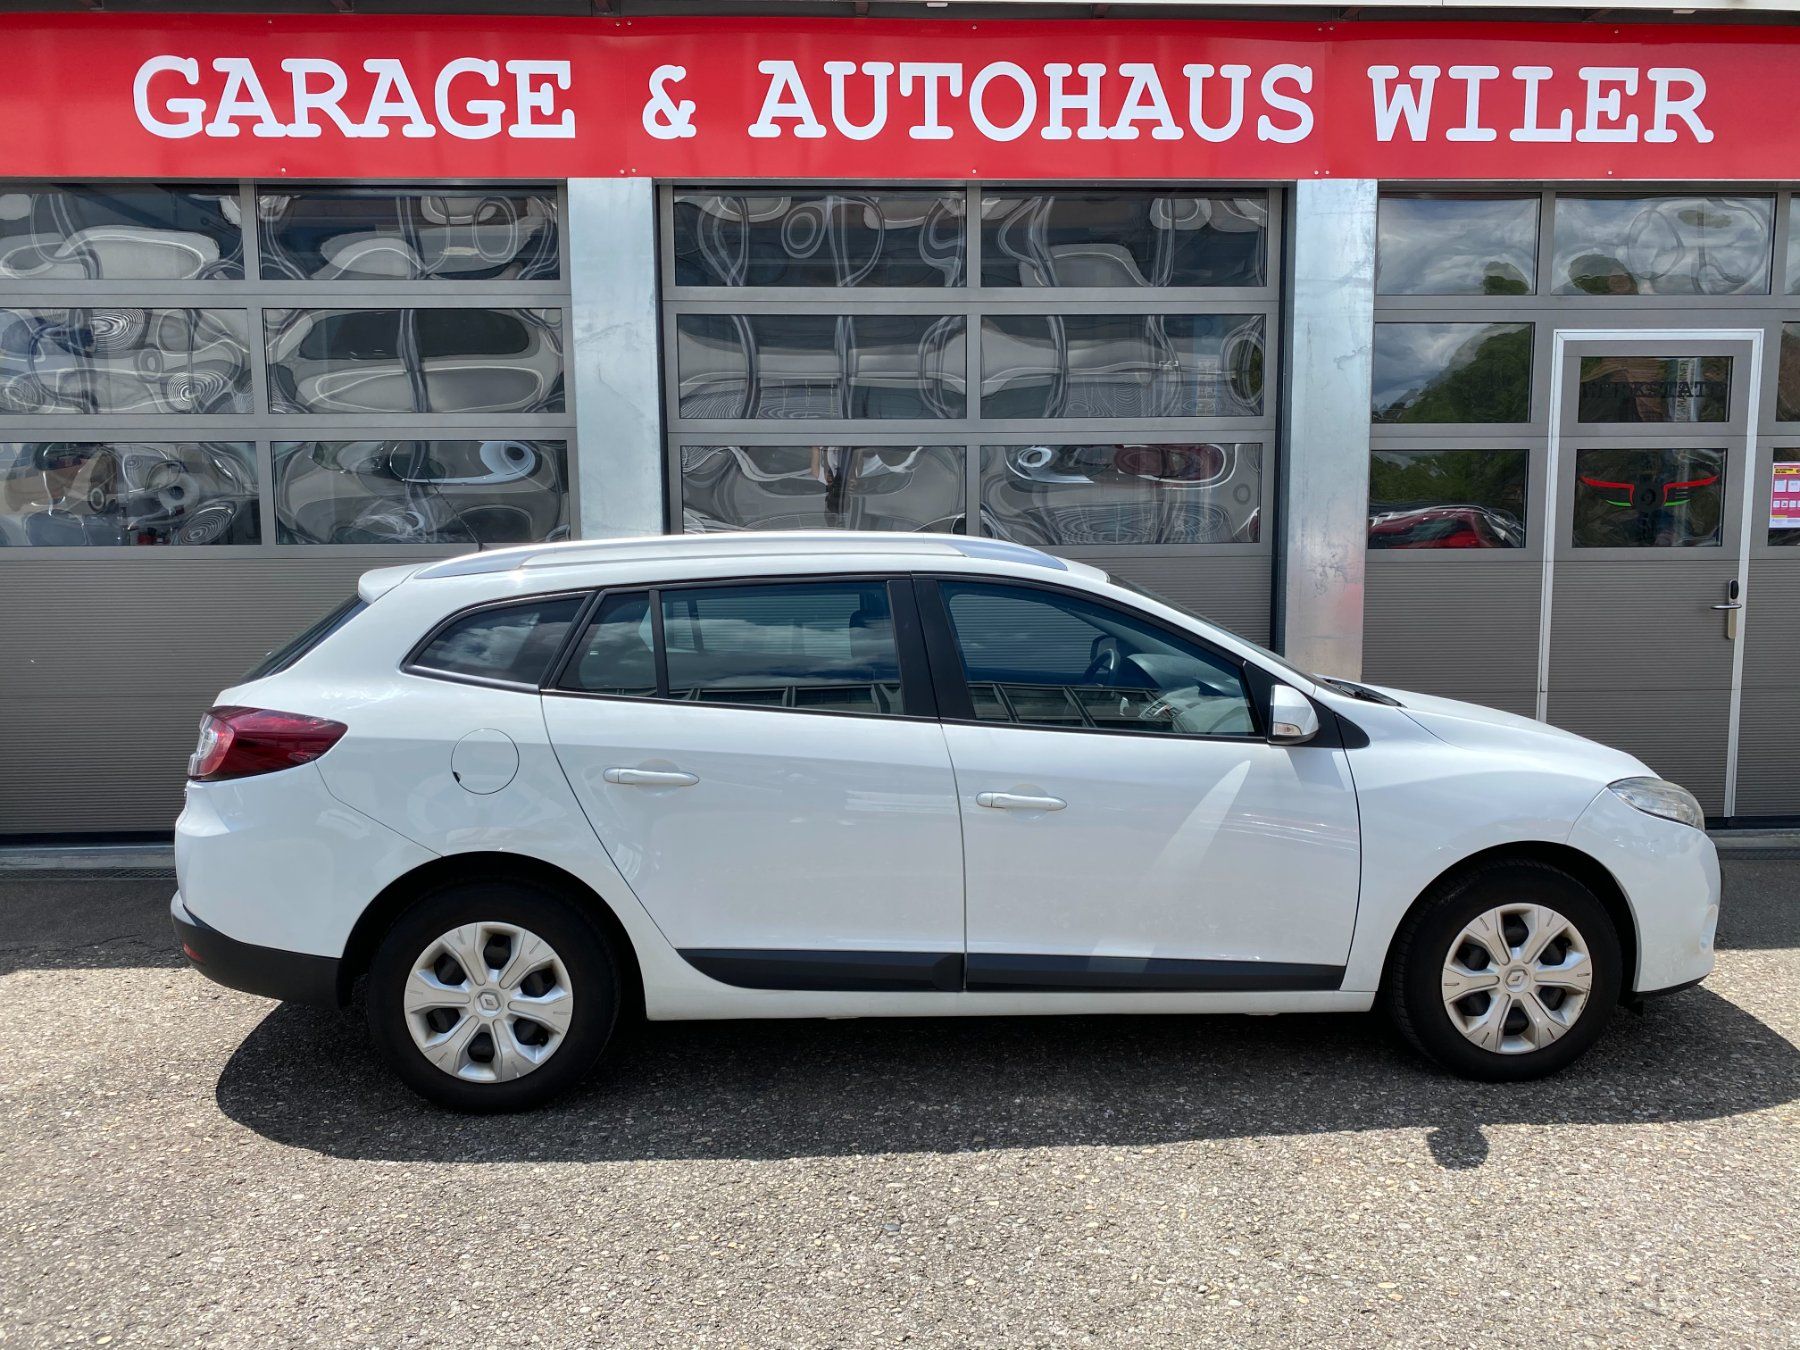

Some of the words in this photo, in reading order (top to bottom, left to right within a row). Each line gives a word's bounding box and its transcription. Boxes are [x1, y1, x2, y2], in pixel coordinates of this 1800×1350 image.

[133, 55, 576, 140] GARAGE
[642, 64, 697, 140] &
[747, 60, 1314, 144] AUTOHAUS
[1367, 65, 1715, 144] WILER
